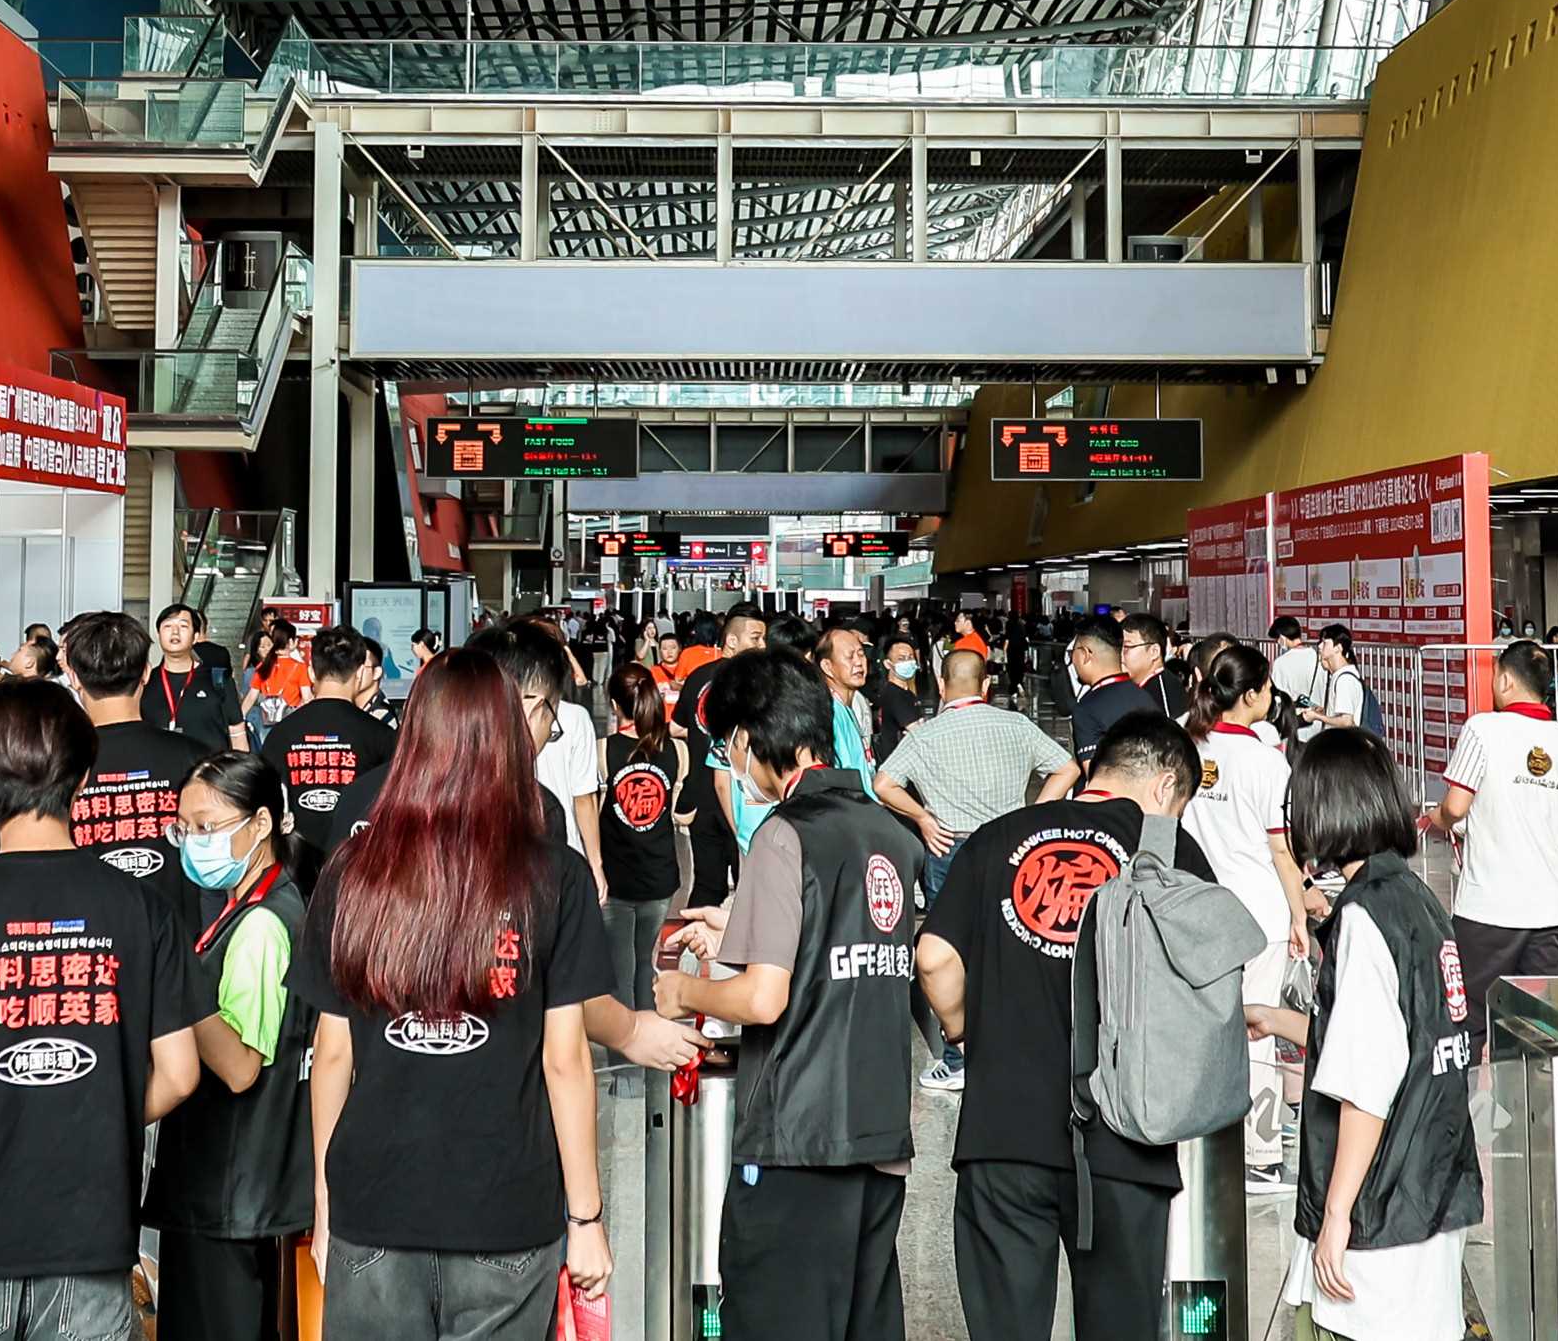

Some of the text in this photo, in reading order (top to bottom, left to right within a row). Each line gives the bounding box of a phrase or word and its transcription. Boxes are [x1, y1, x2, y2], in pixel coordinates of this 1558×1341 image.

[550, 438, 575, 446] FOOD
[1089, 439, 1140, 448] FAST FOOD
[1062, 828, 1095, 840] HOT
[830, 942, 916, 982] GFE组委
